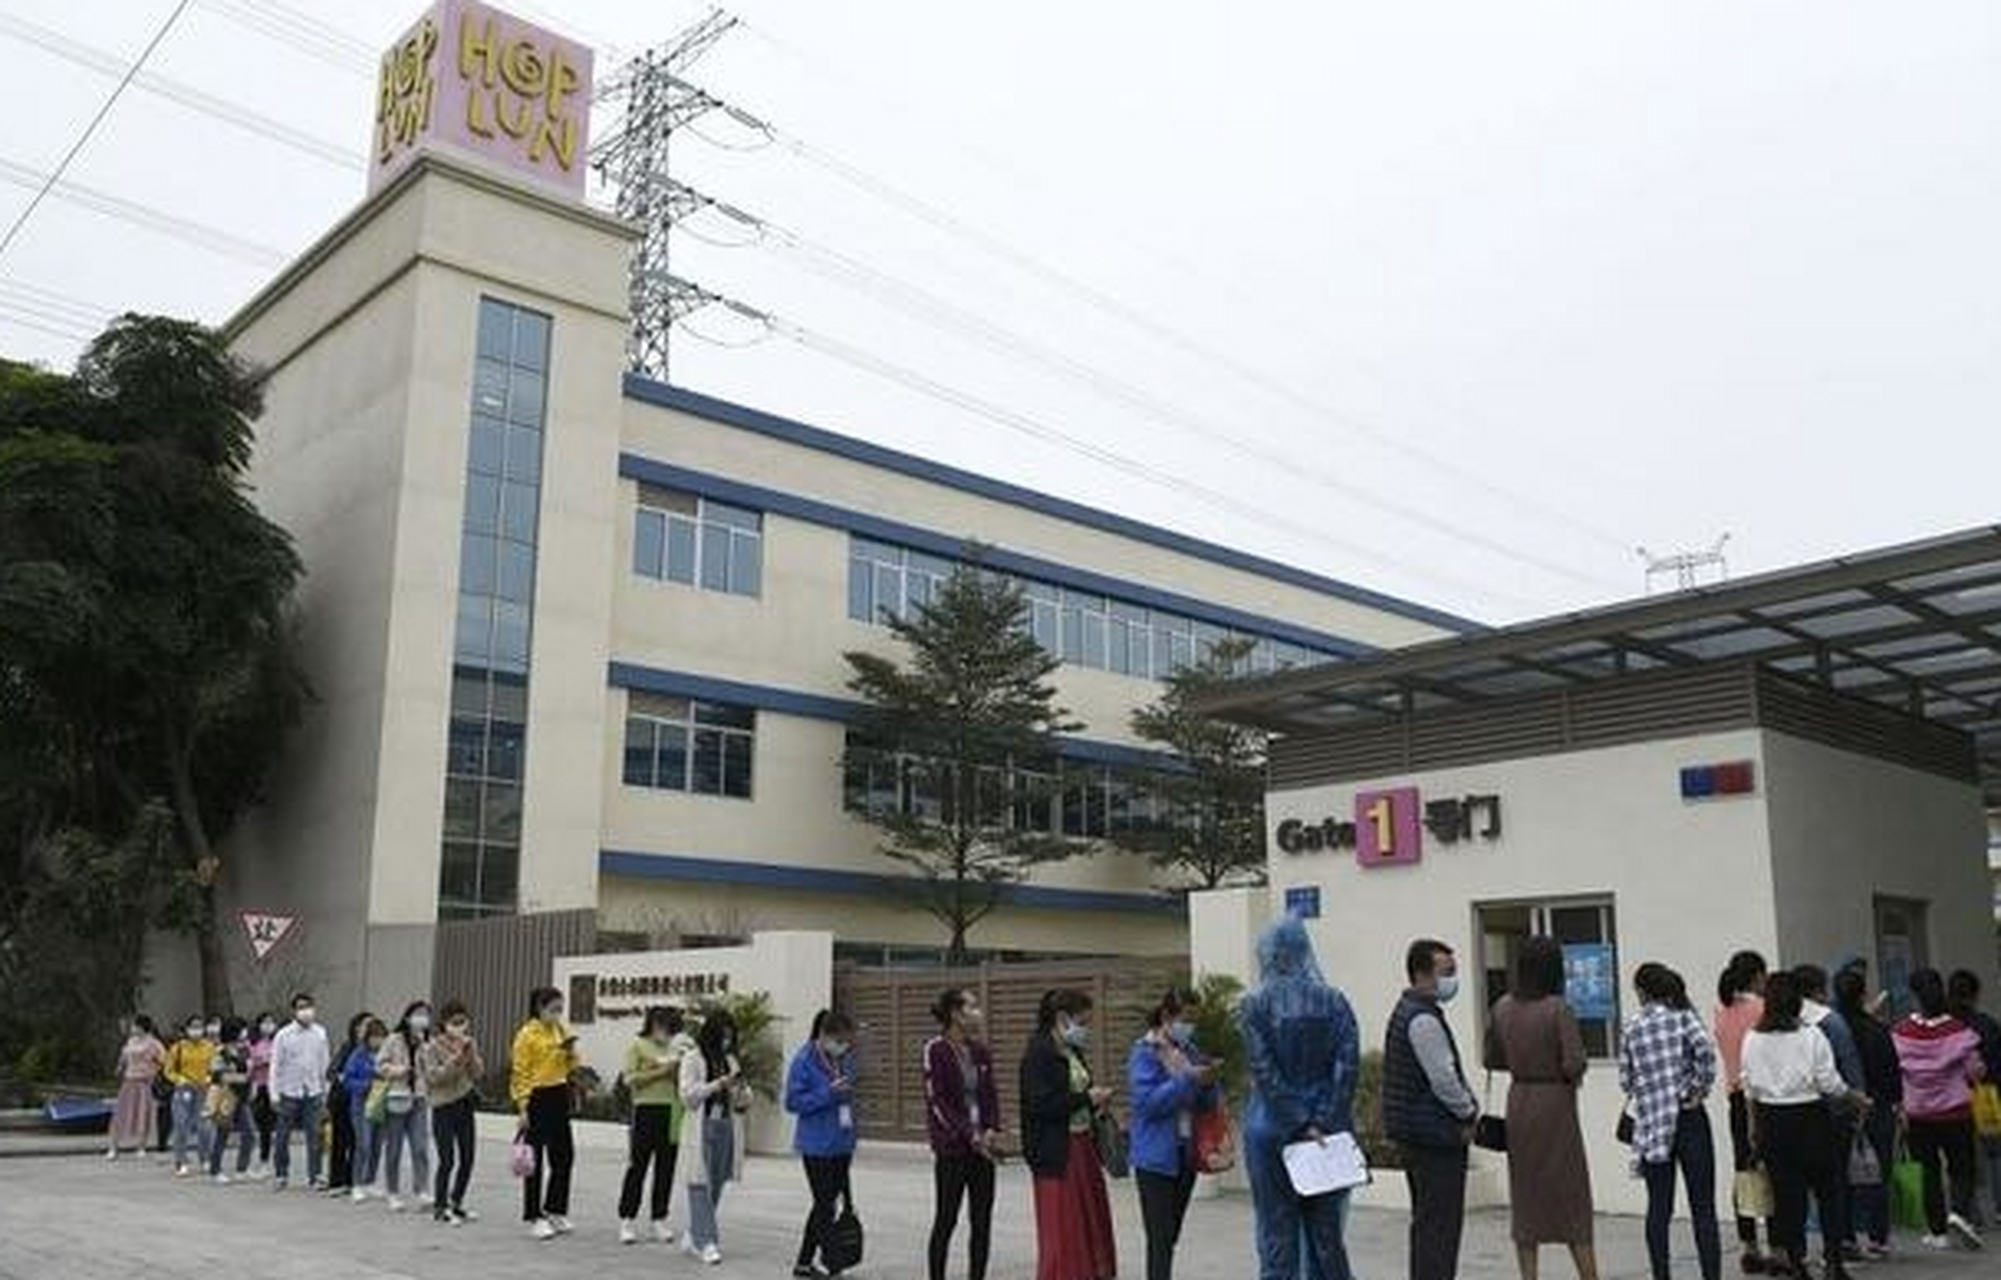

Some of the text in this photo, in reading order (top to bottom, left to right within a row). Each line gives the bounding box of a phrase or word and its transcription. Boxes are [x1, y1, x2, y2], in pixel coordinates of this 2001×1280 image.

[458, 9, 580, 120] HOP
[467, 88, 578, 172] LUN
[1276, 816, 1357, 854] Gate
[1366, 795, 1396, 857] 1
